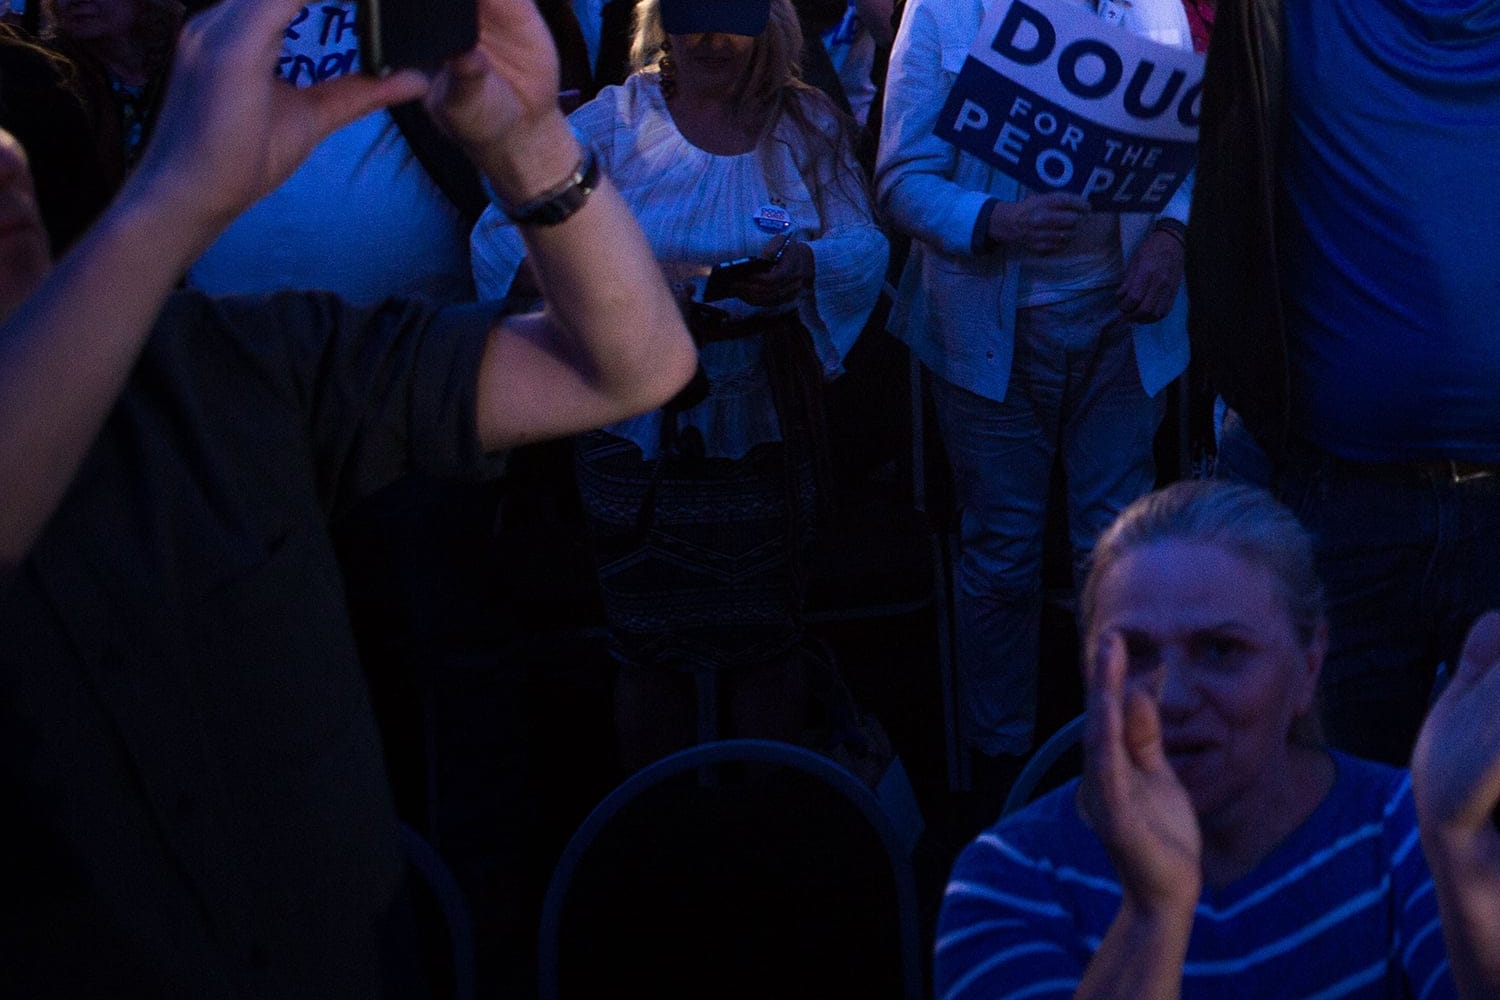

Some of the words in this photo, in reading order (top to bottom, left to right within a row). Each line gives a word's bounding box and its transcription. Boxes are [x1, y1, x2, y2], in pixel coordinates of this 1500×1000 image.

[953, 99, 1177, 204] PEOPLE
[1010, 96, 1084, 152] FOR
[1105, 139, 1162, 168] THE
